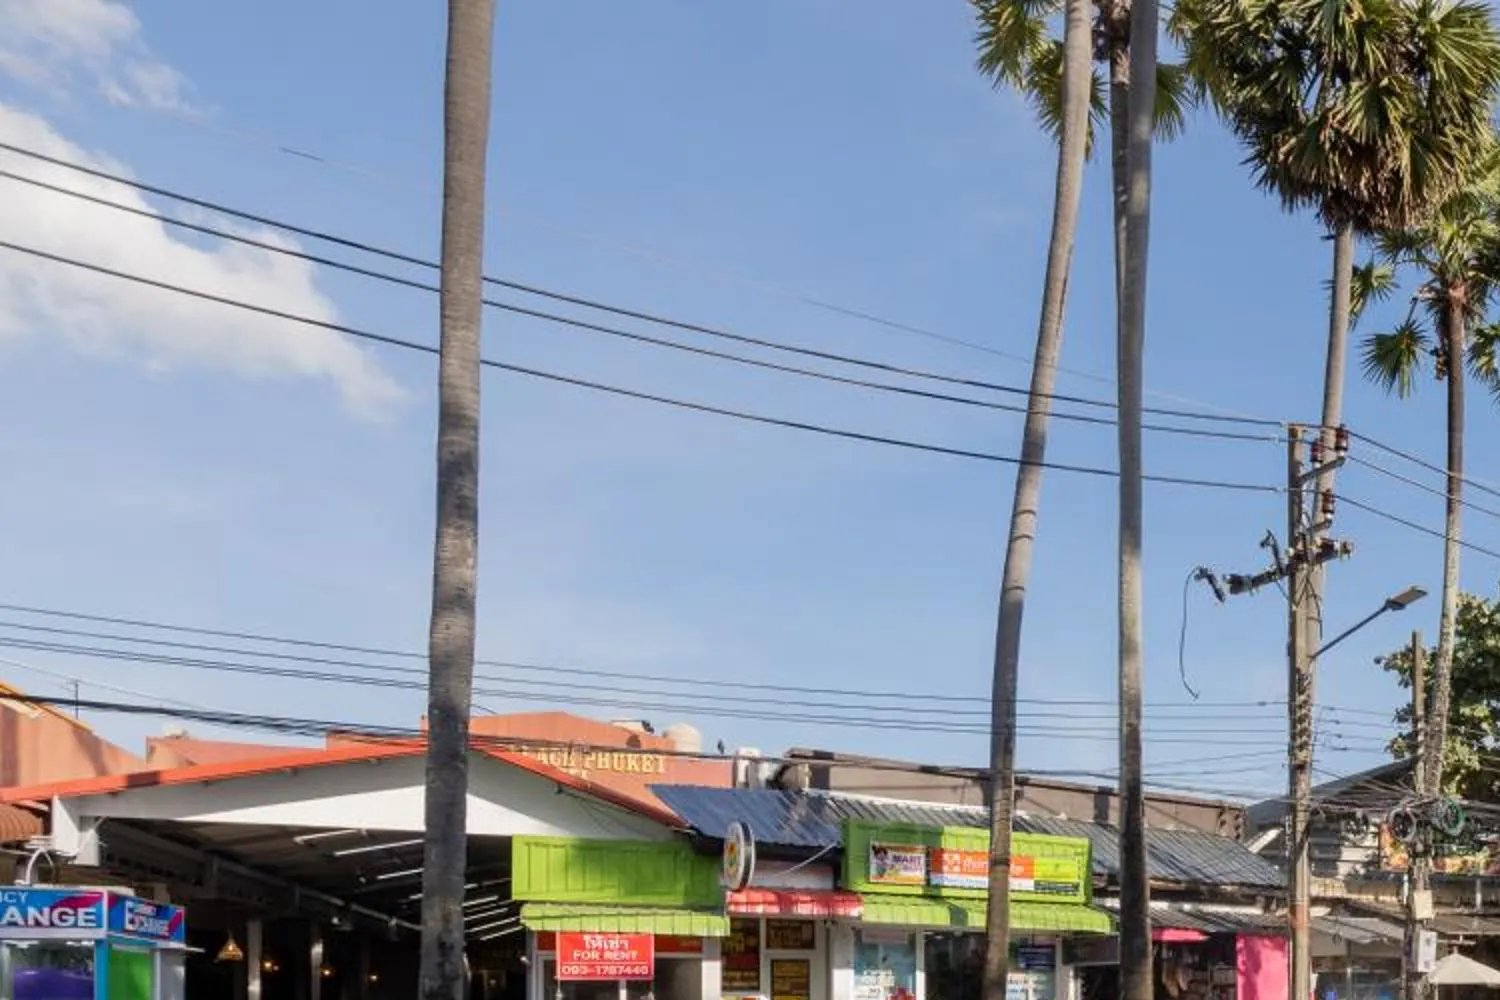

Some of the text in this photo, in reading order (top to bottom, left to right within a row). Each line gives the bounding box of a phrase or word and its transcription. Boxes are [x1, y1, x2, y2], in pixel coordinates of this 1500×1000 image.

[583, 750, 666, 774] PHUKET
[0, 891, 28, 903] CY
[0, 905, 97, 927] ANGE
[573, 949, 639, 961] FOR RENT
